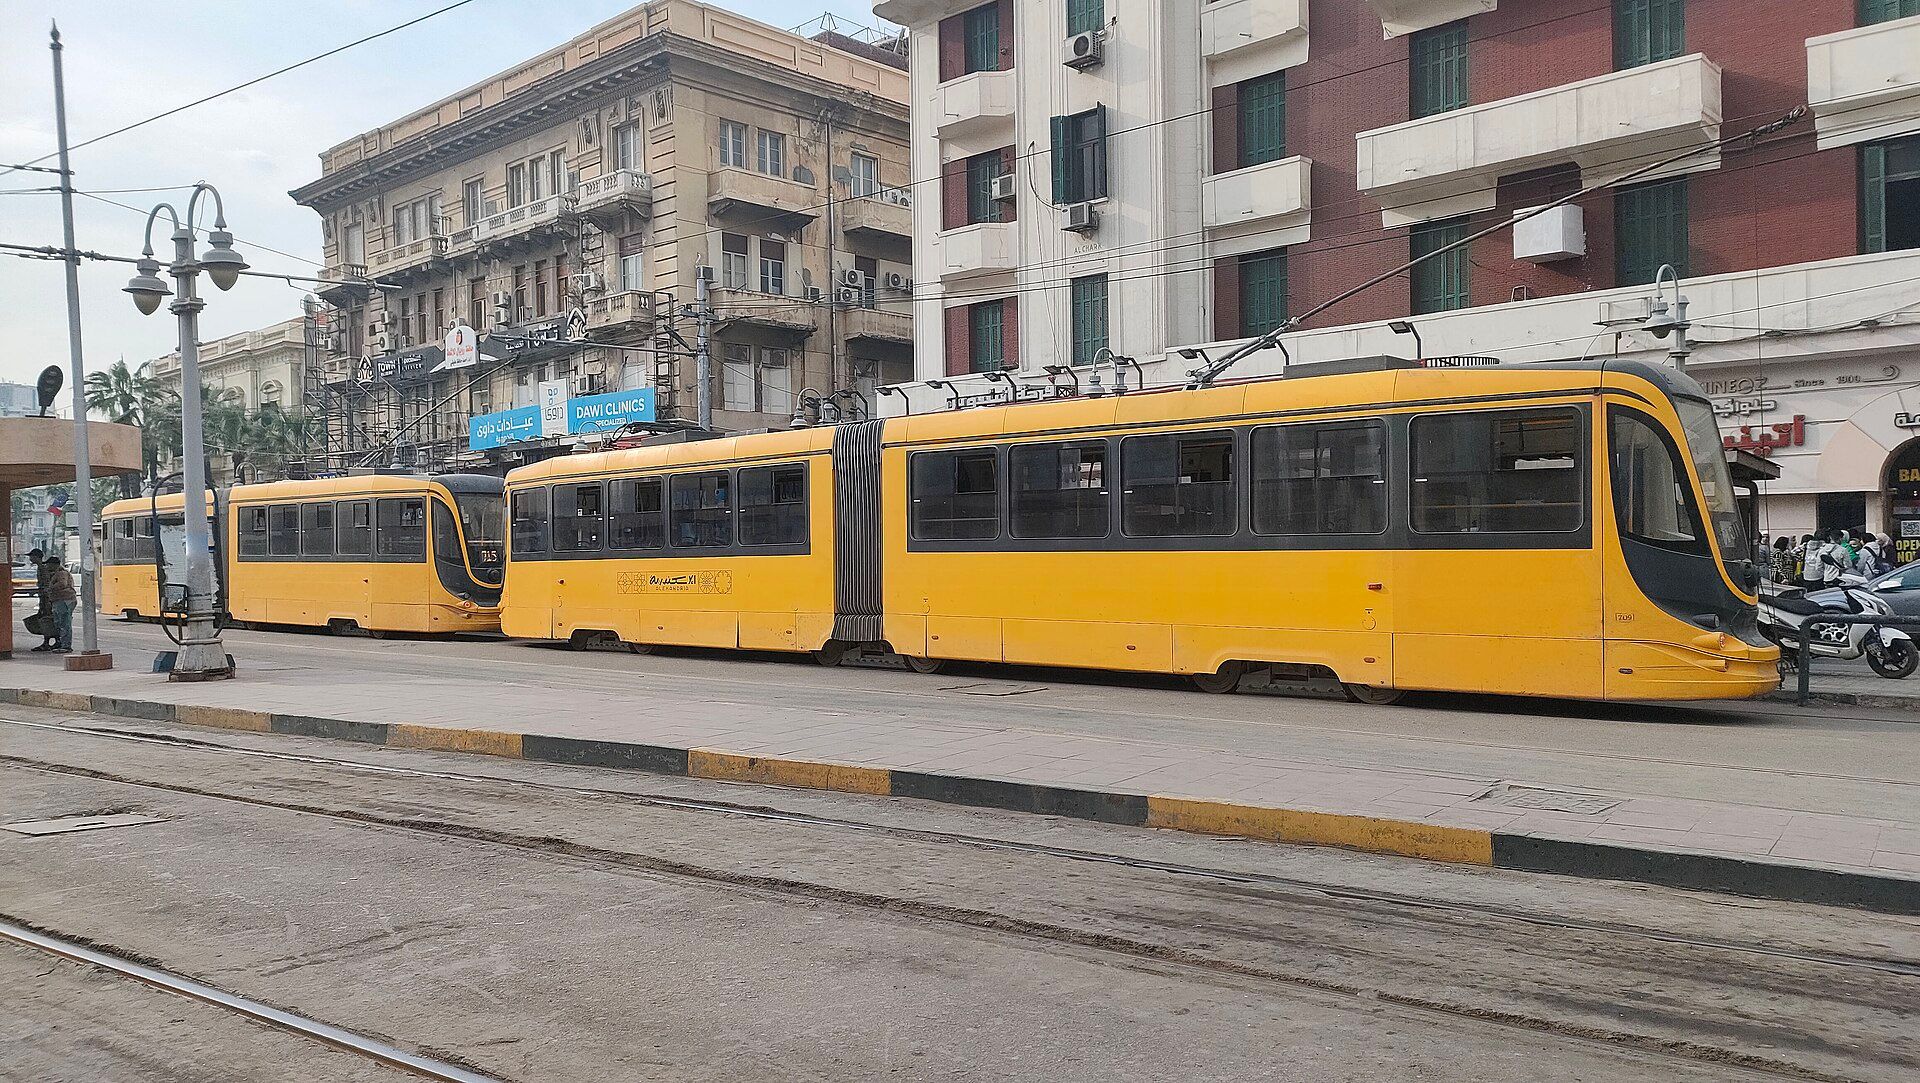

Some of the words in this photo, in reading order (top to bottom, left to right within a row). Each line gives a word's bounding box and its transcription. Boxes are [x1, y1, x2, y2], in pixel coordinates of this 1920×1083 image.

[1794, 379, 1825, 388] Since
[576, 405, 604, 419] DAWI
[605, 398, 645, 416] CLINICS
[595, 416, 627, 427] SPECIALIZED
